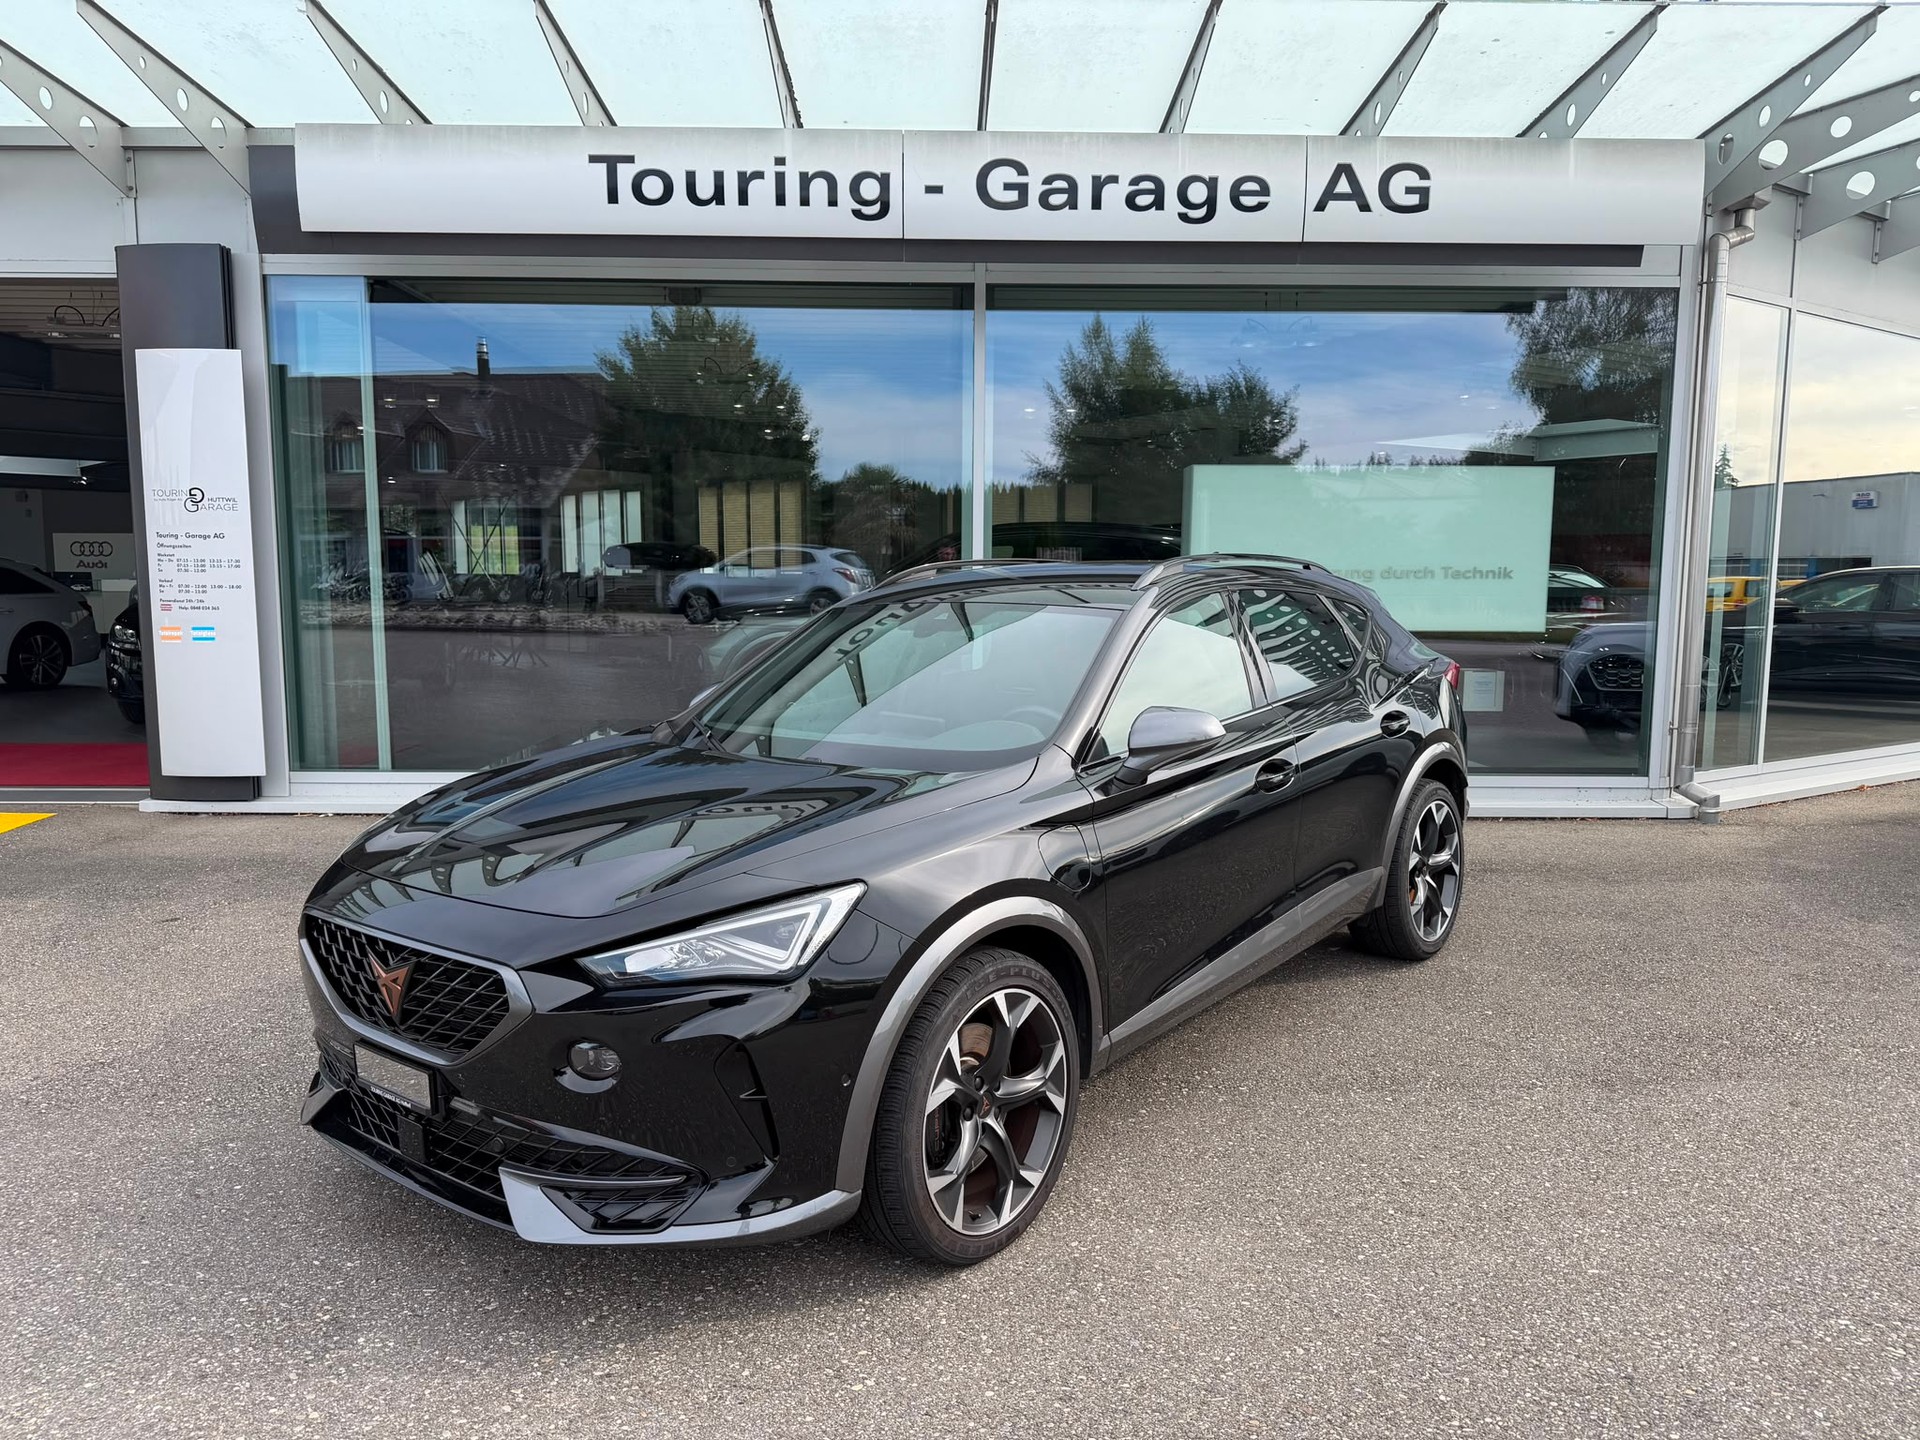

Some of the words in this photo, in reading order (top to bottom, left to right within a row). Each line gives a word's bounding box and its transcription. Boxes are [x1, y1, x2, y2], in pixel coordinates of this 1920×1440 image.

[588, 153, 891, 222] Touring
[924, 184, 944, 194] -
[975, 157, 1271, 225] Garage
[1312, 162, 1432, 214] AG
[183, 497, 239, 513] GARAGE
[156, 531, 179, 540] Touring
[184, 532, 211, 541] Garage
[213, 532, 226, 540] AG
[76, 559, 108, 569] Audi
[1380, 566, 1435, 581] durch
[1441, 566, 1514, 581] Technik
